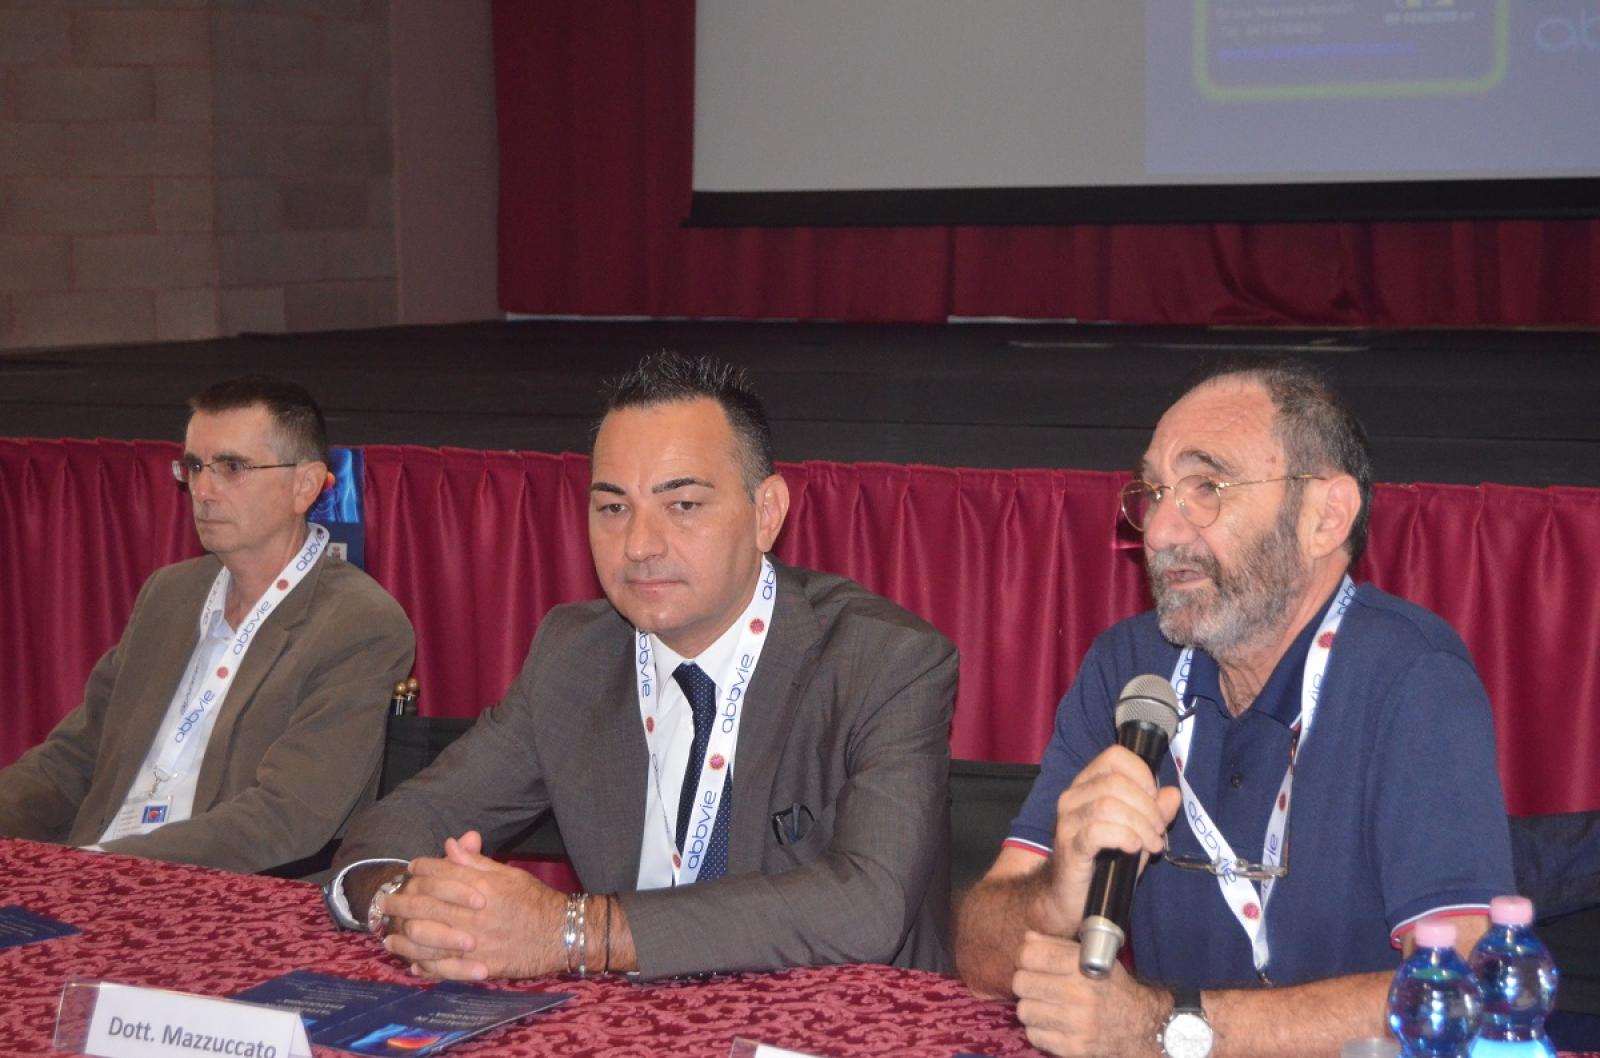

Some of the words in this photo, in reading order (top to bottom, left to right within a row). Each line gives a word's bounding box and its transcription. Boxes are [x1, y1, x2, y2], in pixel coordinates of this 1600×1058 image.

[233, 601, 271, 655] abbvie
[639, 632, 653, 698] bbvie
[721, 654, 754, 734] abbvie
[175, 690, 215, 743] abbvie
[688, 789, 717, 869] abbvie
[109, 1016, 154, 1042] Dott.
[162, 1025, 277, 1058] Mazzuccato
